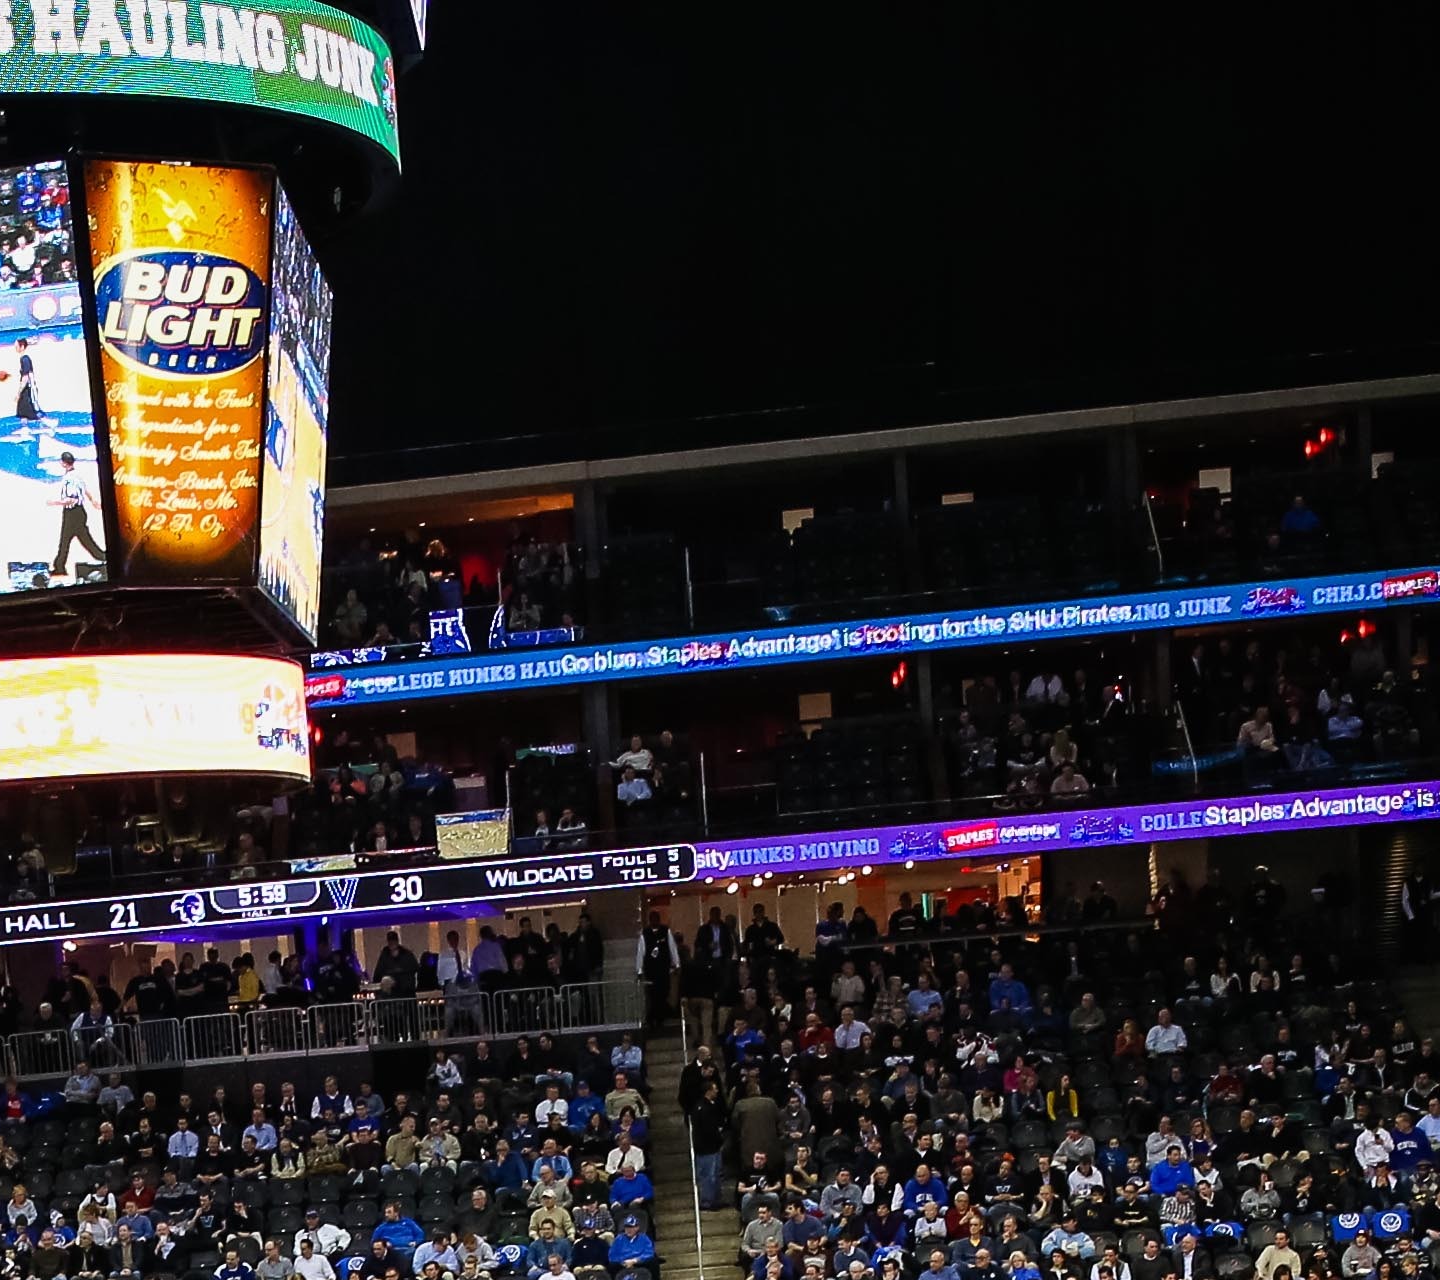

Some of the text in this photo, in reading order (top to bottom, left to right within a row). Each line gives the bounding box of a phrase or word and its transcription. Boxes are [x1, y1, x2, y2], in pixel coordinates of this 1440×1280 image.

[31, 0, 285, 74] HAULING
[295, 24, 380, 108] JUNK
[122, 261, 249, 306] BUD
[104, 301, 263, 350] LIGHT
[142, 513, 167, 532] 12
[1174, 596, 1232, 617] JUNK
[648, 615, 1006, 665] Staples is rooting for the
[1205, 804, 1285, 829] Staples
[1416, 788, 1434, 808] is
[601, 849, 679, 869] FOULS 5
[620, 865, 681, 881] TOL 5
[390, 864, 594, 902] 30 WILDCATS
[5, 913, 76, 934] HALL
[109, 903, 139, 930] 21
